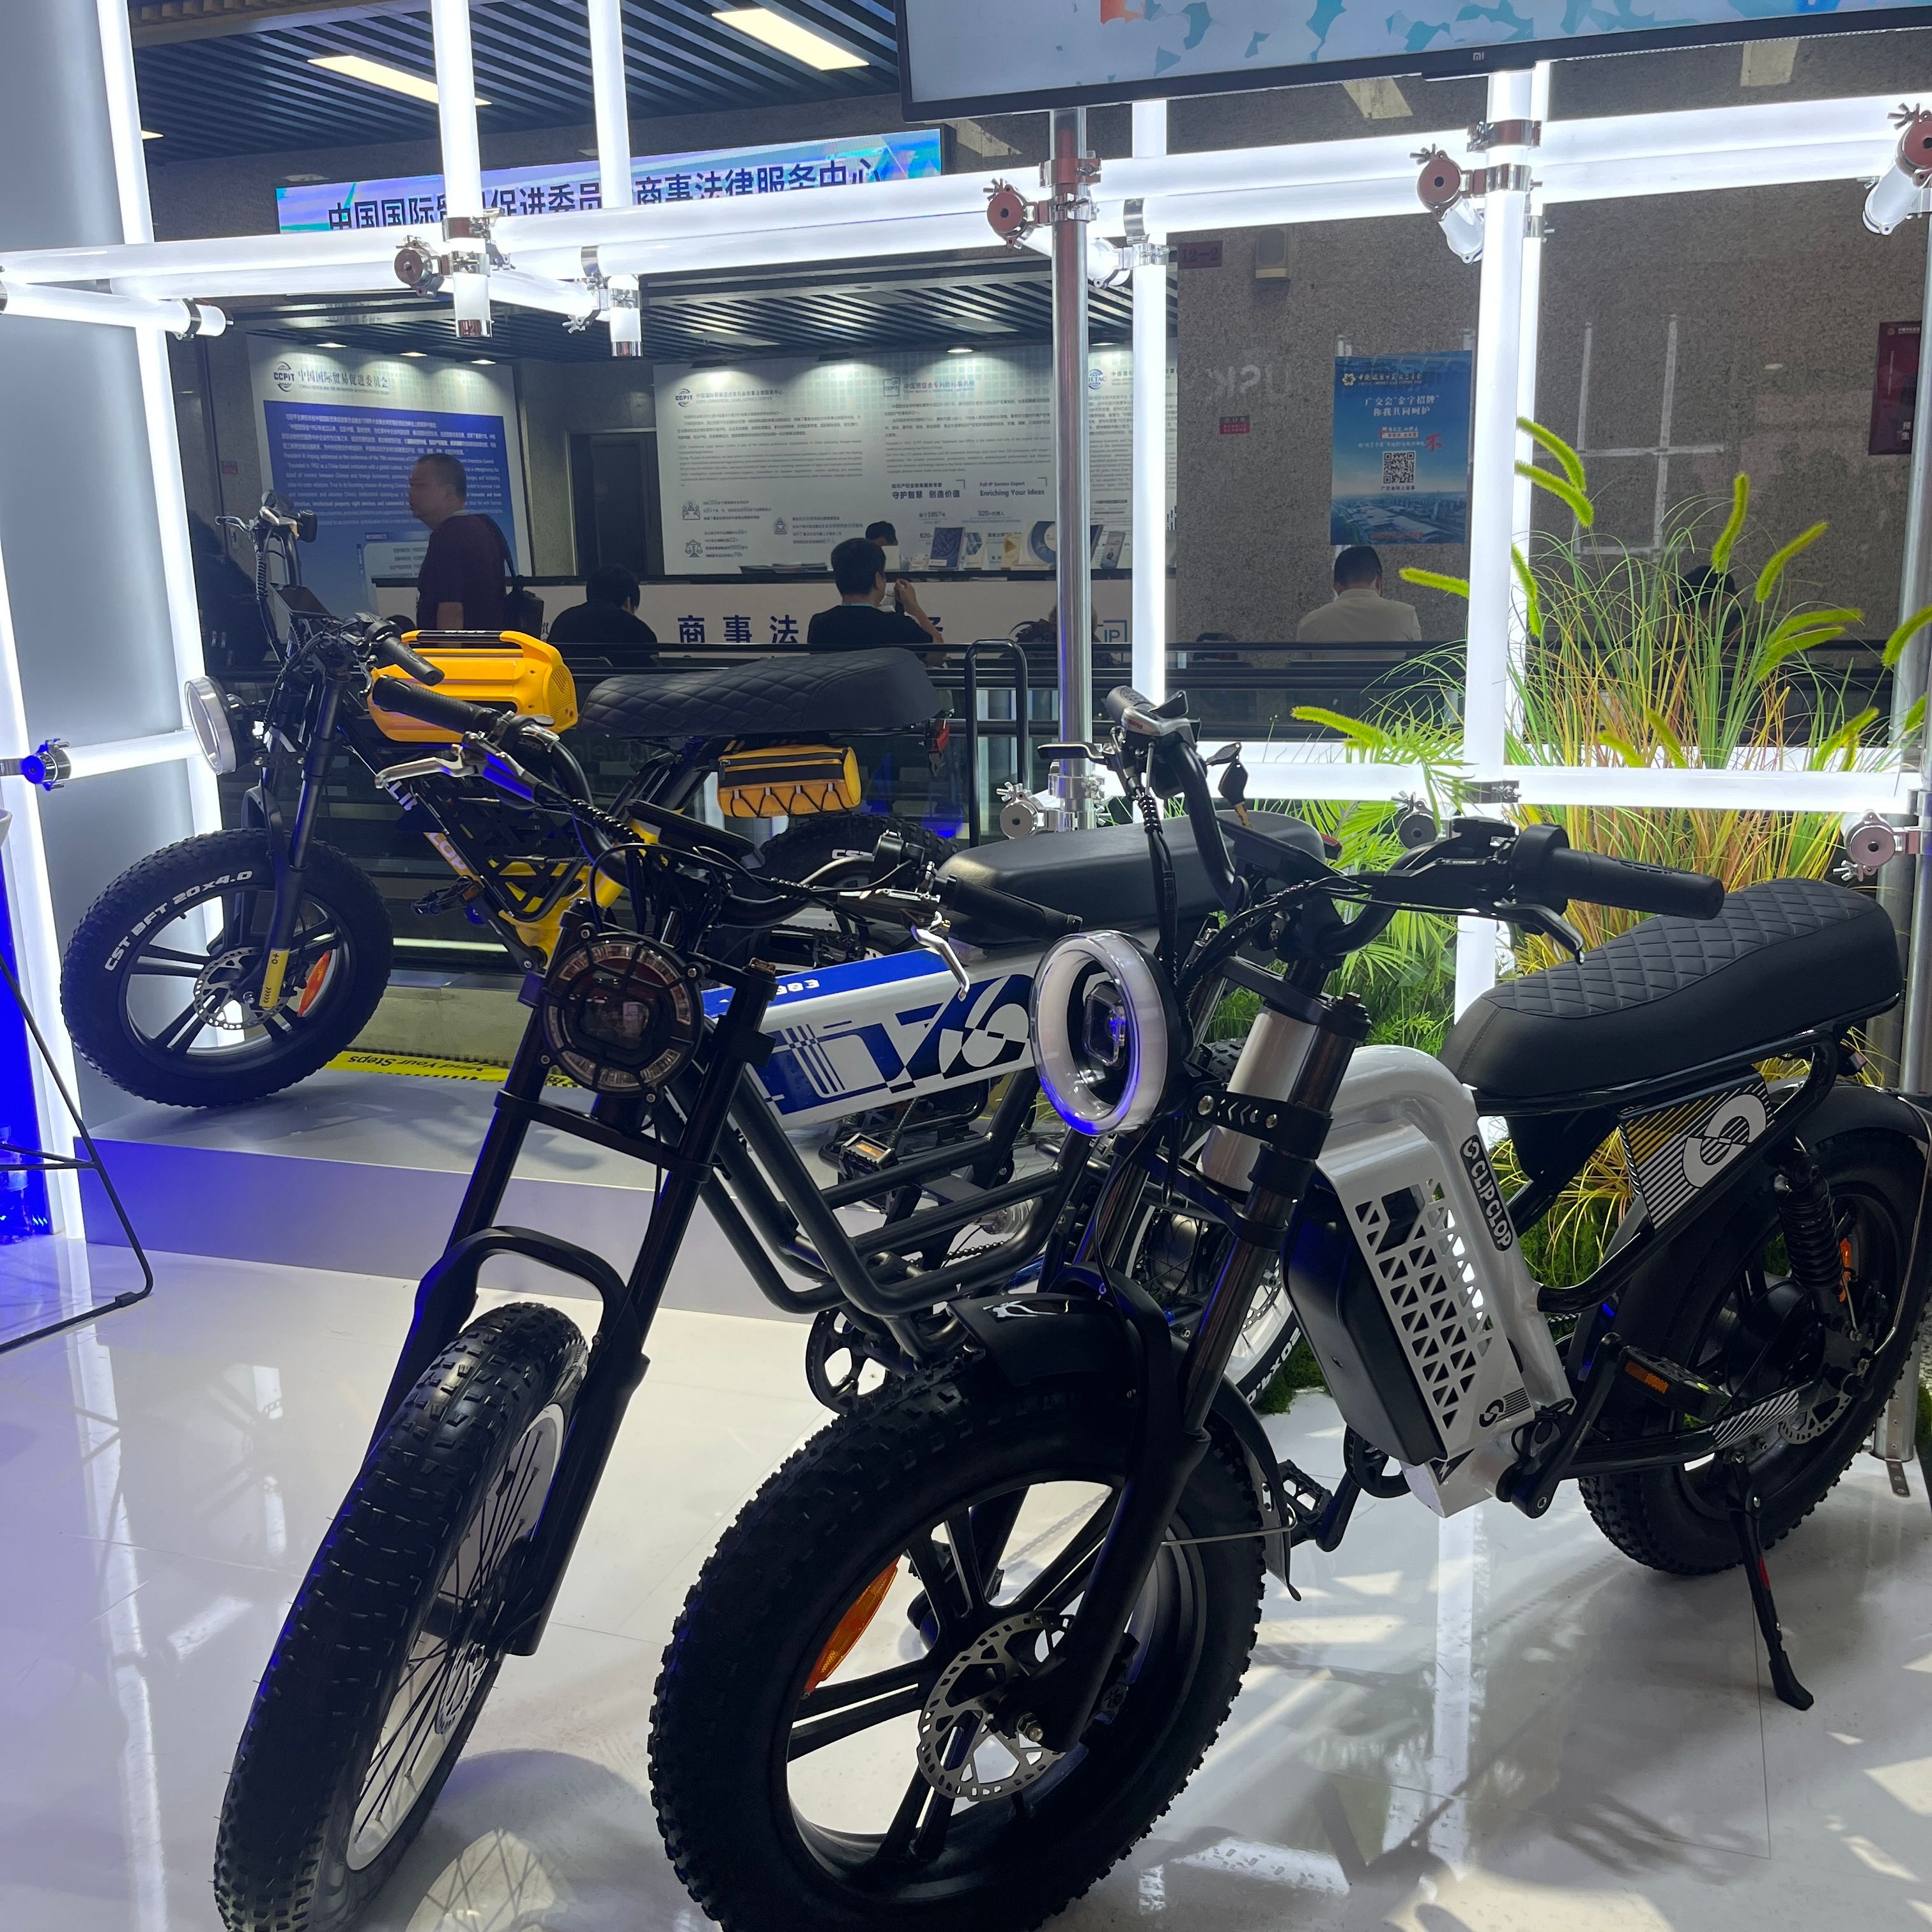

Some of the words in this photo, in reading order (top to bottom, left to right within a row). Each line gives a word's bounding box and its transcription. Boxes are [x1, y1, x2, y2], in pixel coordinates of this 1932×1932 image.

[273, 372, 295, 382] CCPIT
[892, 490, 923, 500] 守护智慧
[929, 490, 961, 498] 创造价值
[980, 490, 1009, 498] Enriching
[104, 936, 131, 972] CST
[131, 902, 168, 937] BFT
[172, 870, 253, 905] 20x4.0
[347, 1054, 397, 1067] Steps
[397, 1059, 436, 1068] Your
